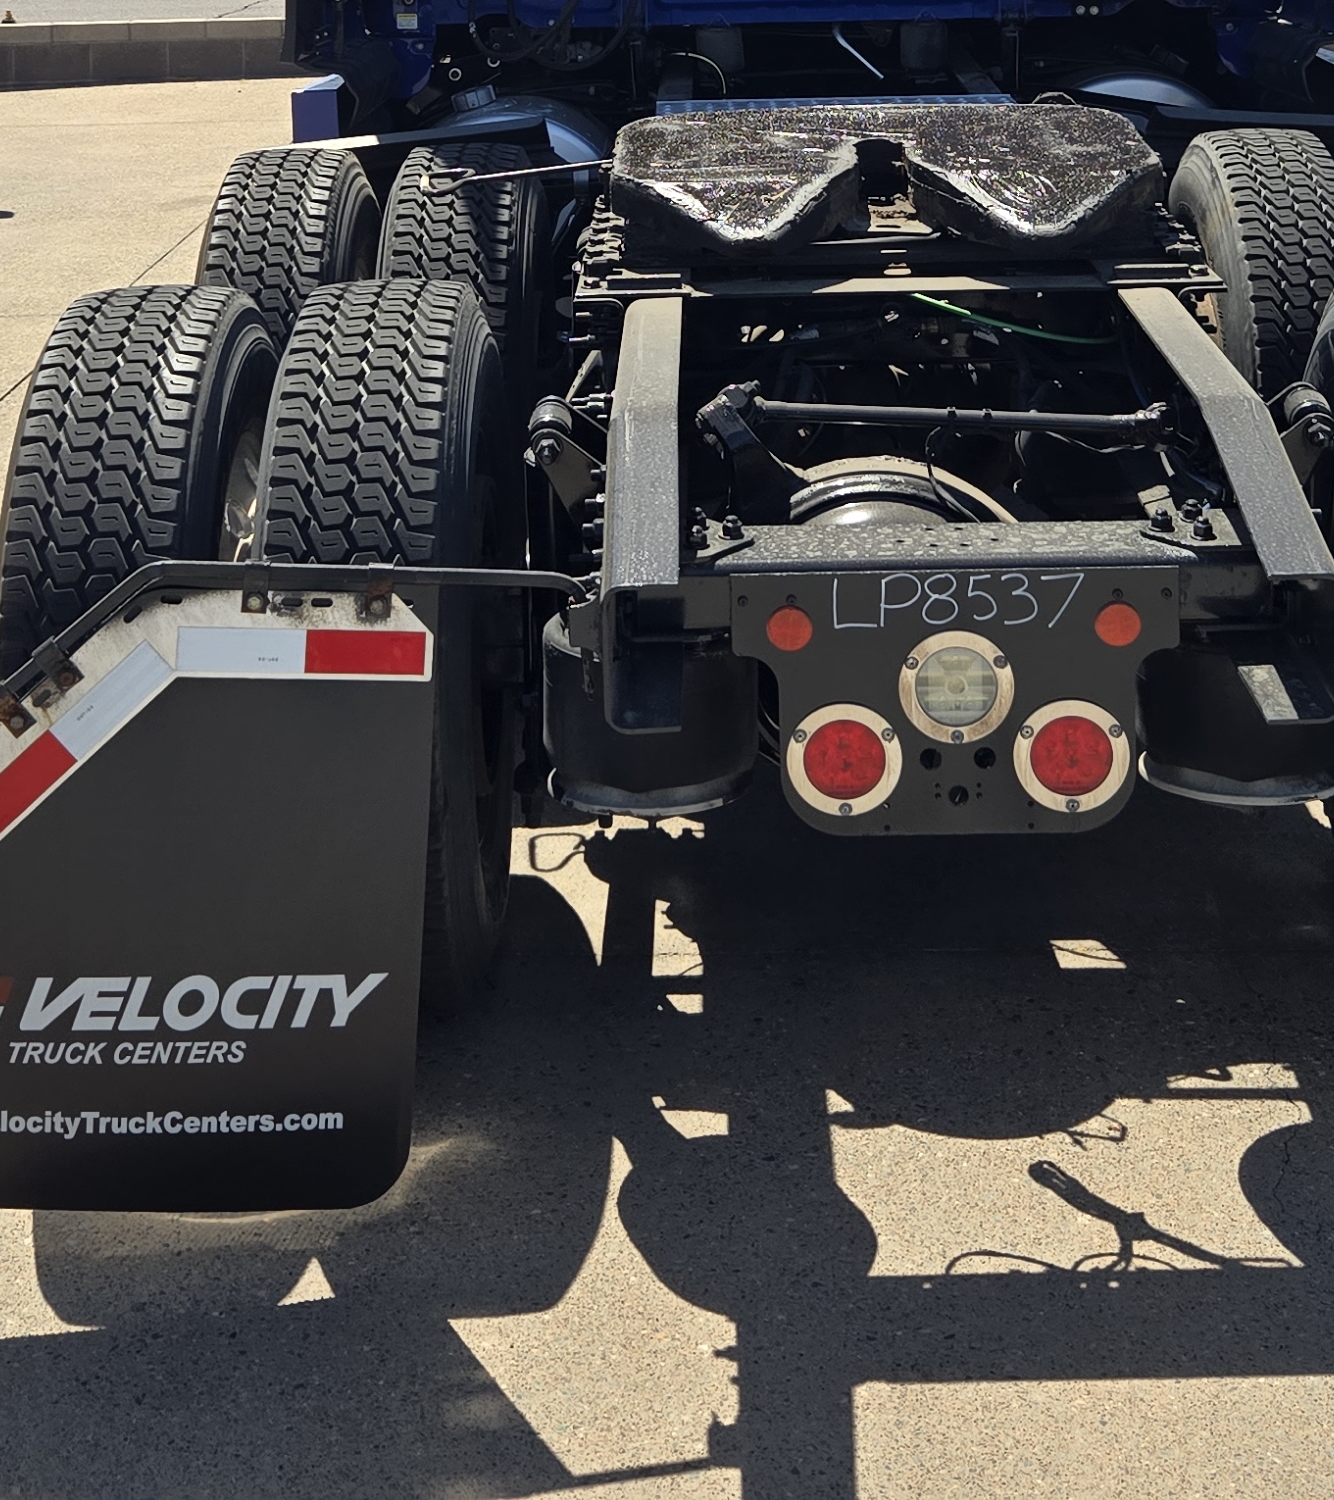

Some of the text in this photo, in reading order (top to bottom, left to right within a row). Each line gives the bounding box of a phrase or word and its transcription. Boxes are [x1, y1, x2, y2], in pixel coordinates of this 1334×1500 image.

[833, 573, 1085, 628] LP8537
[19, 972, 389, 1031] VELOCITY
[8, 1040, 247, 1065] TRUCK CENTERS
